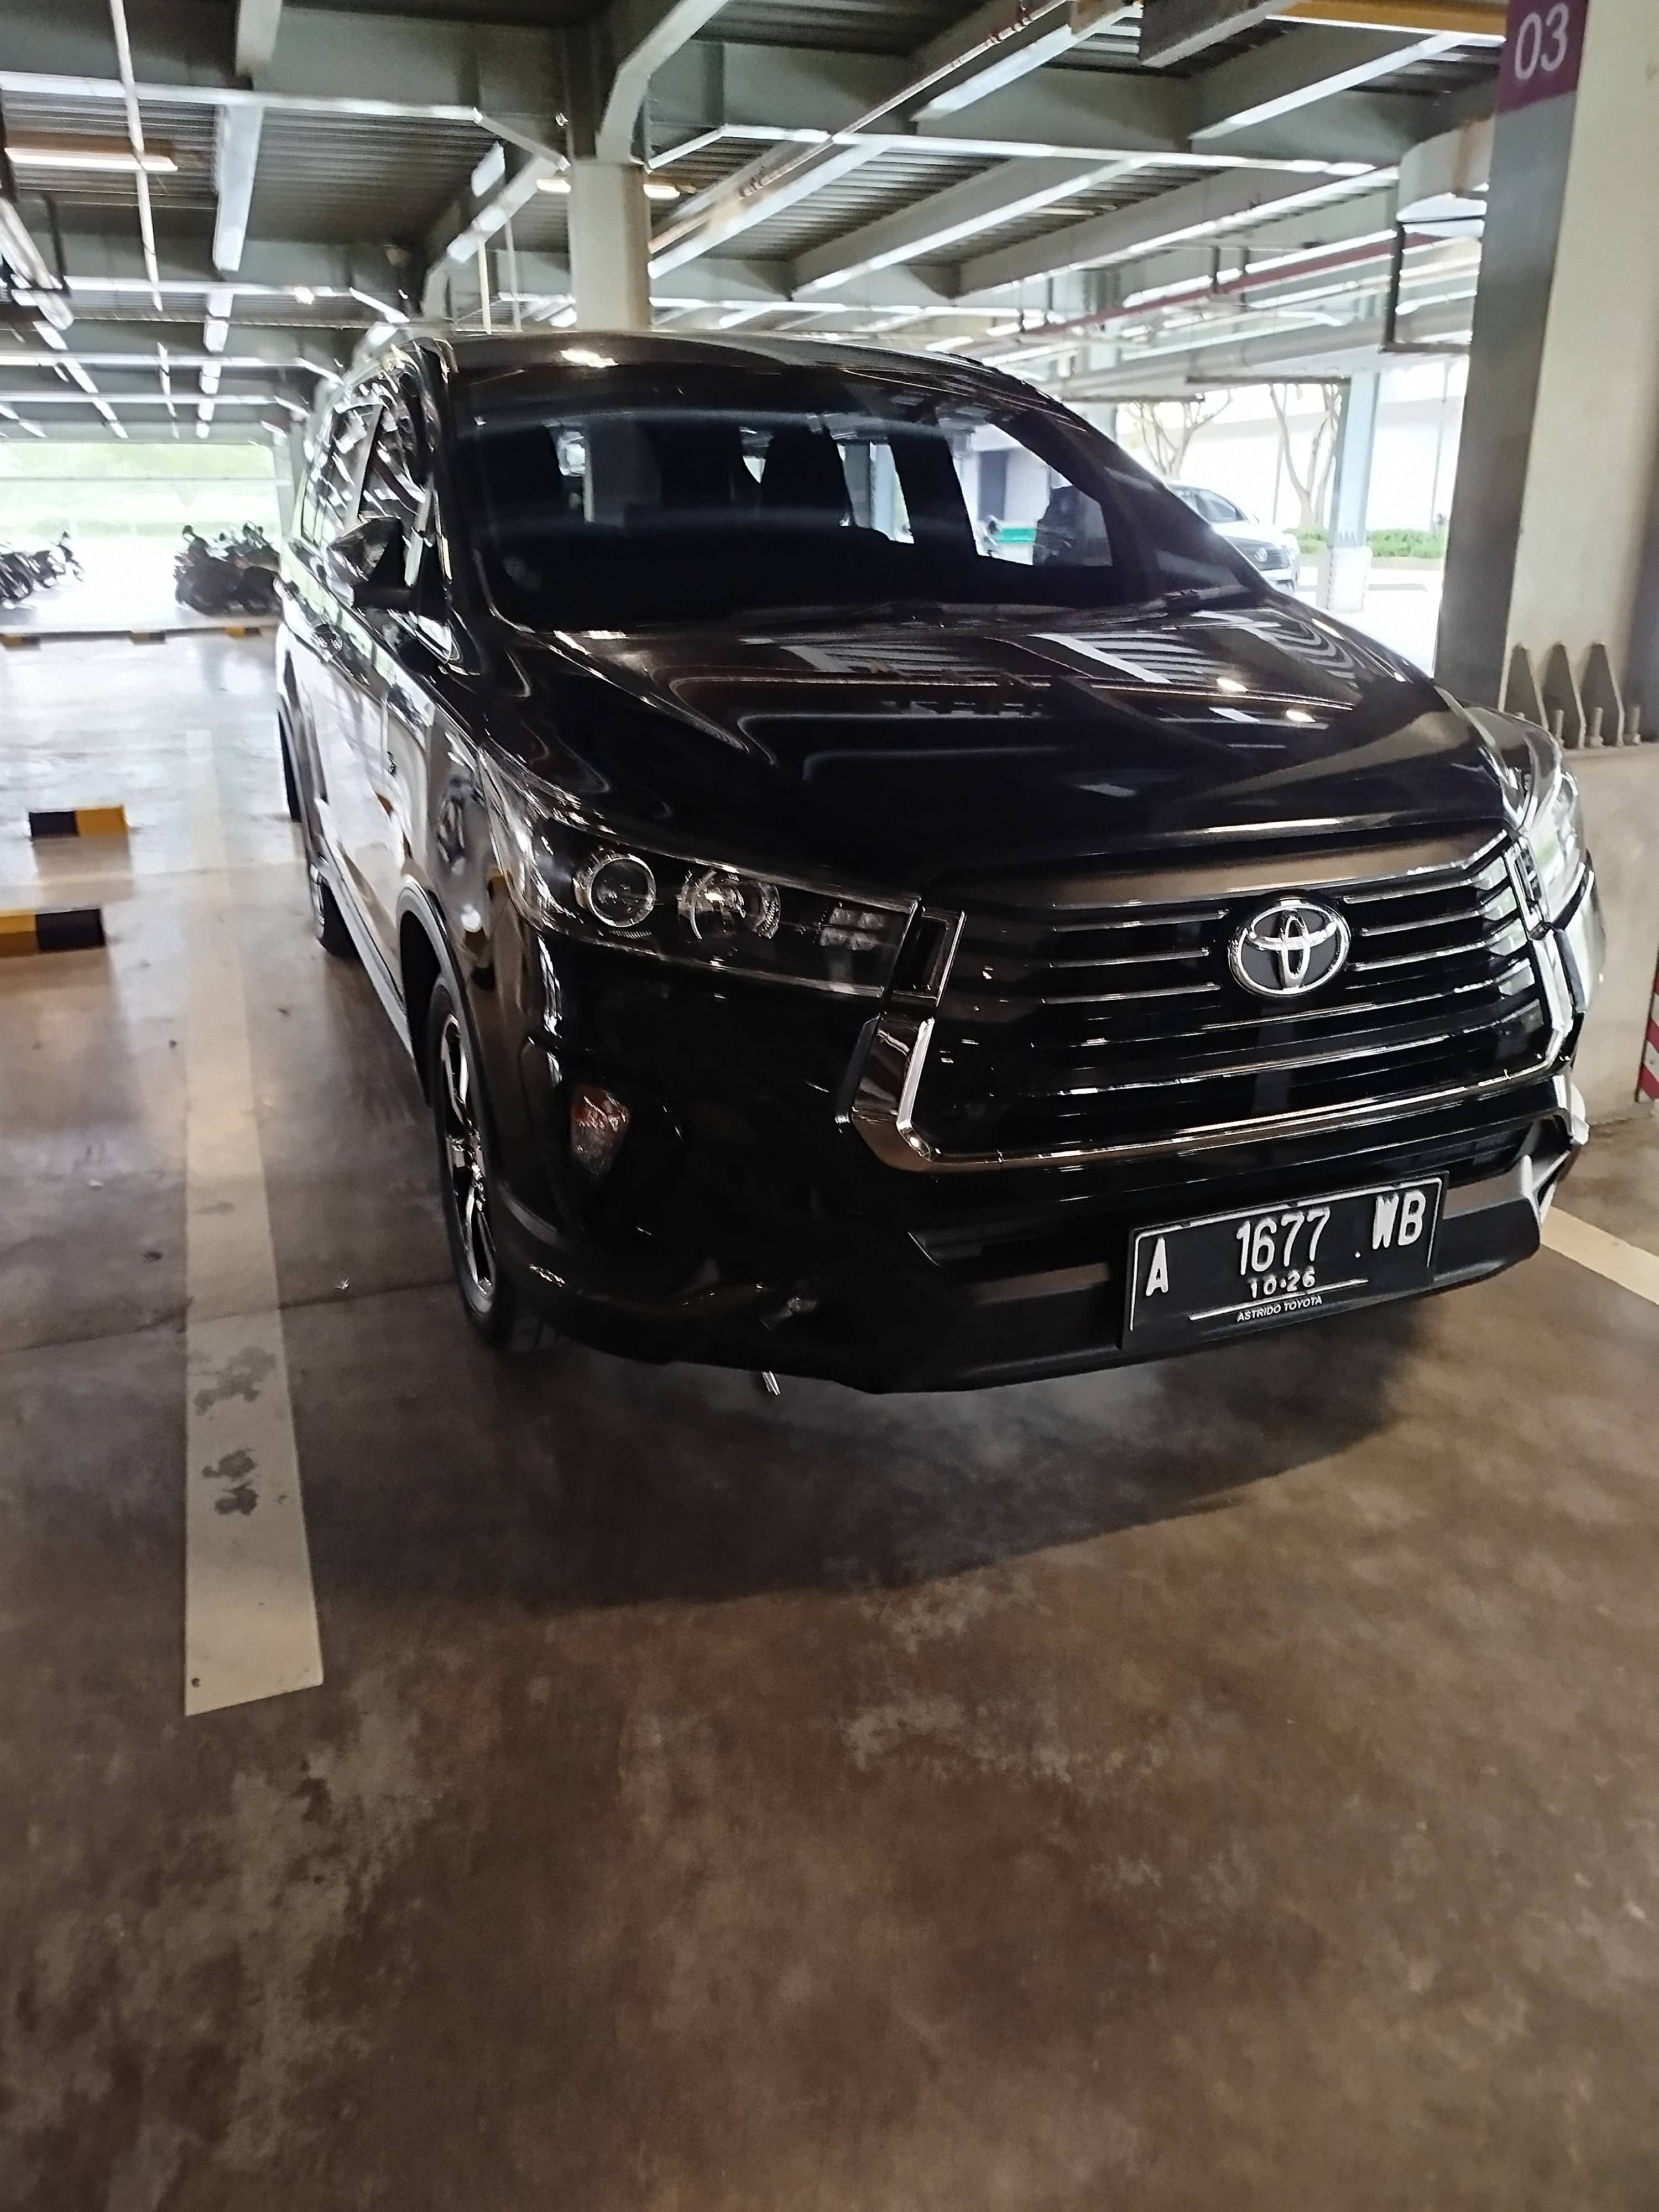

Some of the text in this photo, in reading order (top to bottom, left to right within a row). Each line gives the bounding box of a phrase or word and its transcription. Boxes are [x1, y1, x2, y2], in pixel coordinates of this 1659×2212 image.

[1515, 3, 1569, 80] 03
[1145, 1190, 1426, 1296] A 1677 WB
[1237, 1295, 1322, 1322] ASTRIDO TOYOTA
